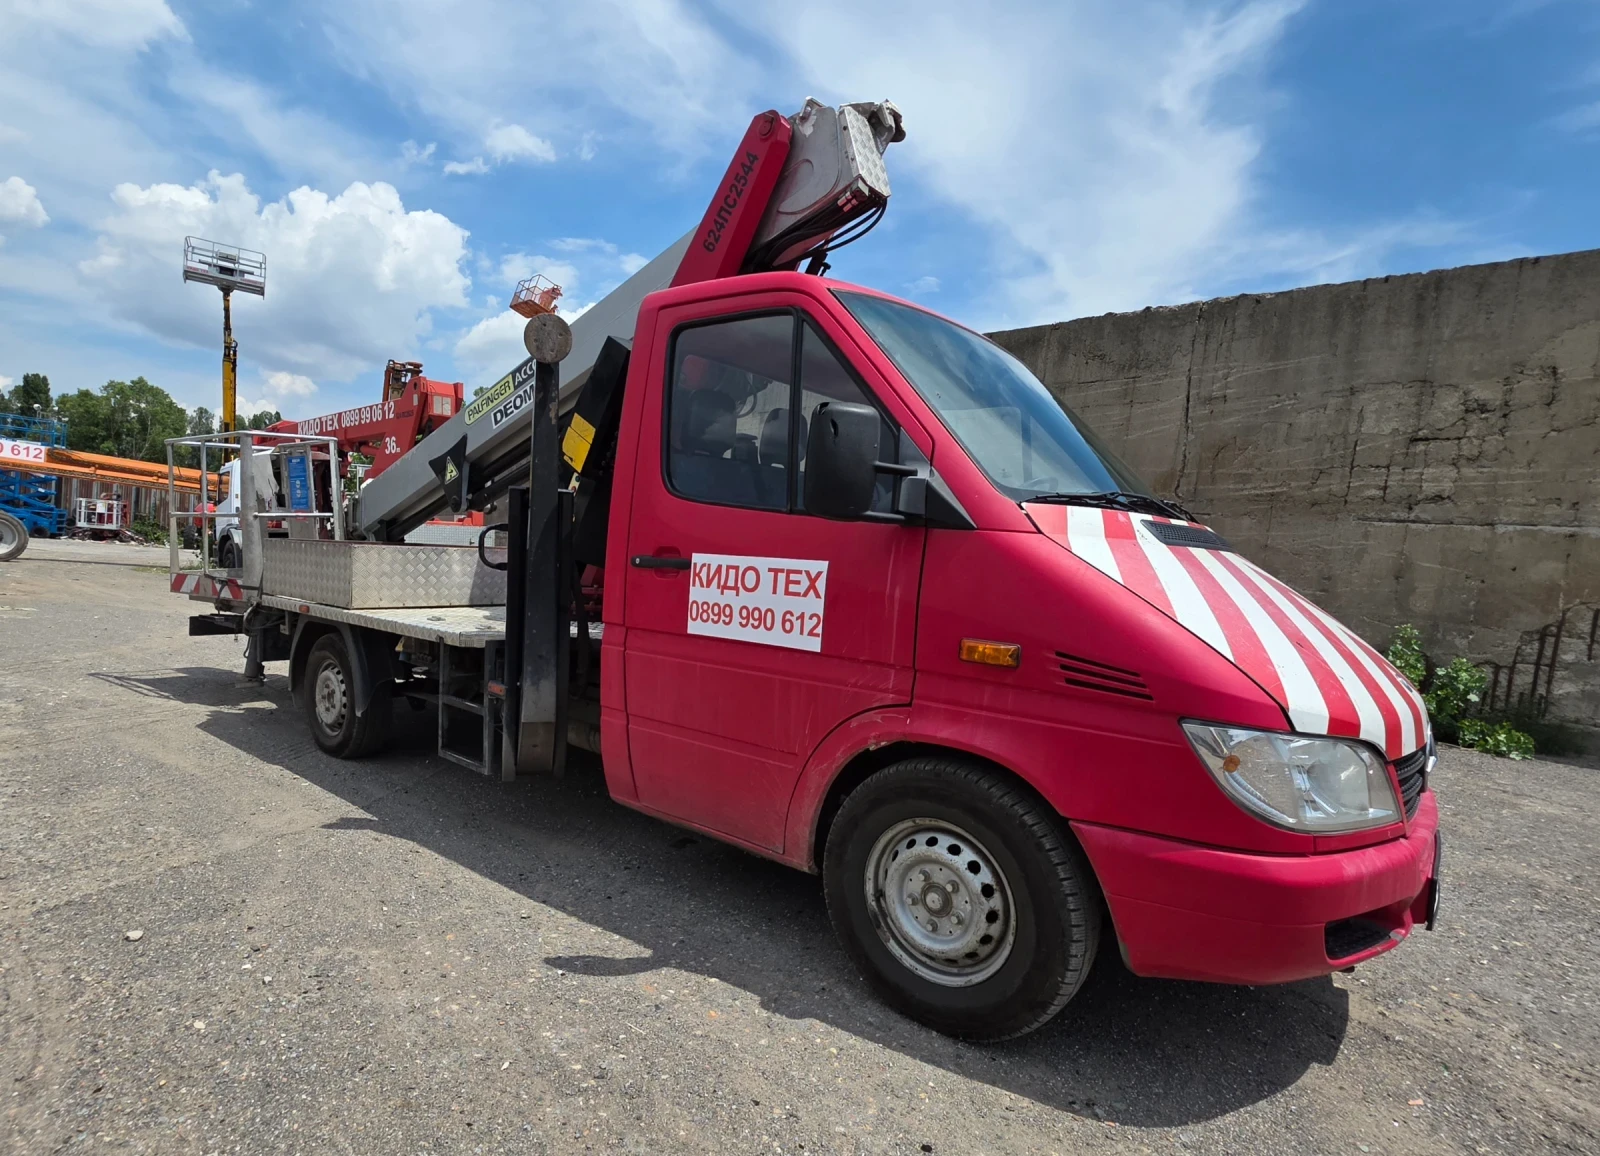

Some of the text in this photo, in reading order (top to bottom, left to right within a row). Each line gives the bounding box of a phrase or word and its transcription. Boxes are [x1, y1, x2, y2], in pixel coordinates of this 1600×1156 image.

[703, 151, 759, 253] 624ПС2544
[298, 418, 320, 436] КИДО
[321, 414, 339, 432] ТЕХ
[341, 409, 359, 428] 0899
[360, 407, 371, 424] 99
[372, 404, 382, 422] 06
[384, 401, 395, 419] 12
[467, 380, 511, 421] PALFINGER
[11, 444, 43, 459] 612
[692, 562, 823, 599] КИДО ТЕХ
[689, 600, 822, 638] 0899 990 612
